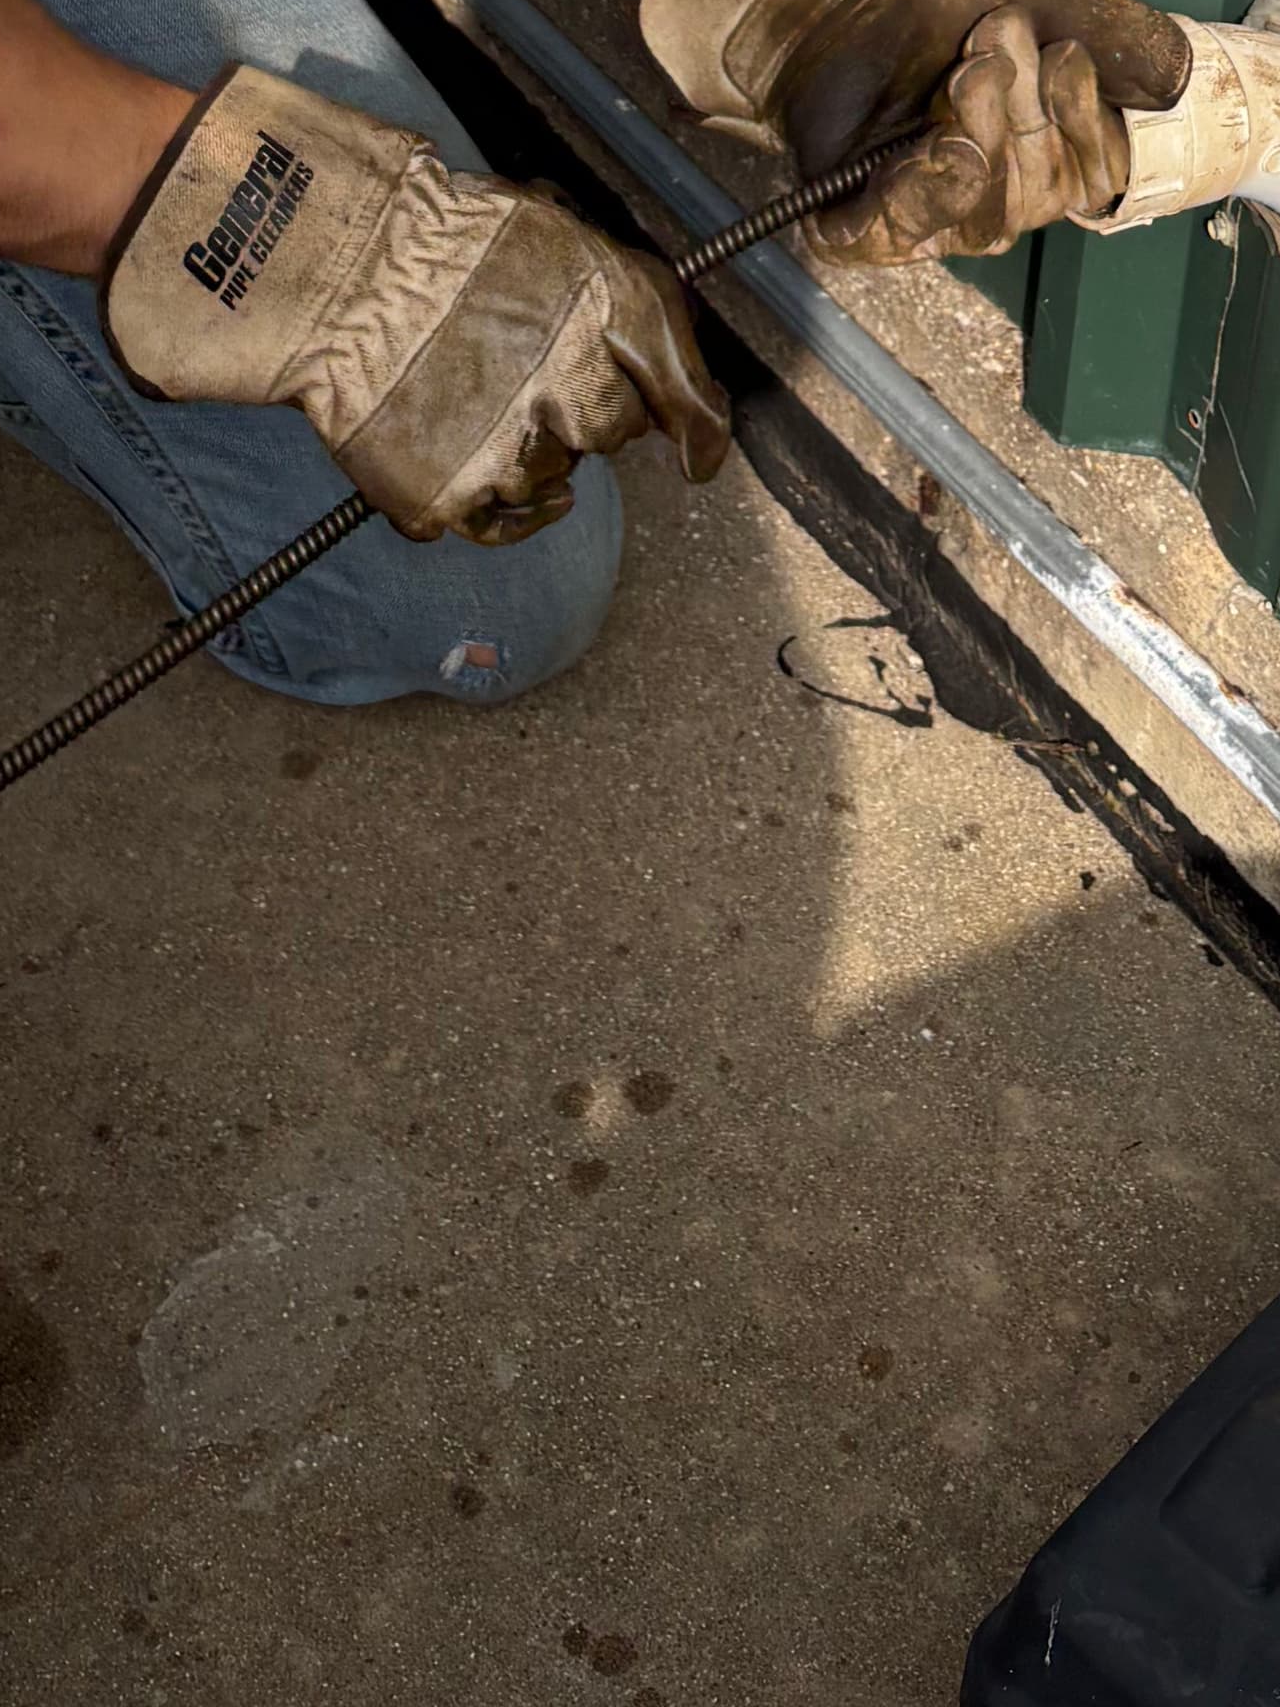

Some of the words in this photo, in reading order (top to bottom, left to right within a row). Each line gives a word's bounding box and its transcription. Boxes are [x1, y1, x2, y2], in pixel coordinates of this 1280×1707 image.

[183, 130, 296, 293] General
[220, 261, 260, 311] PIPE
[249, 160, 314, 265] CLEANERS
